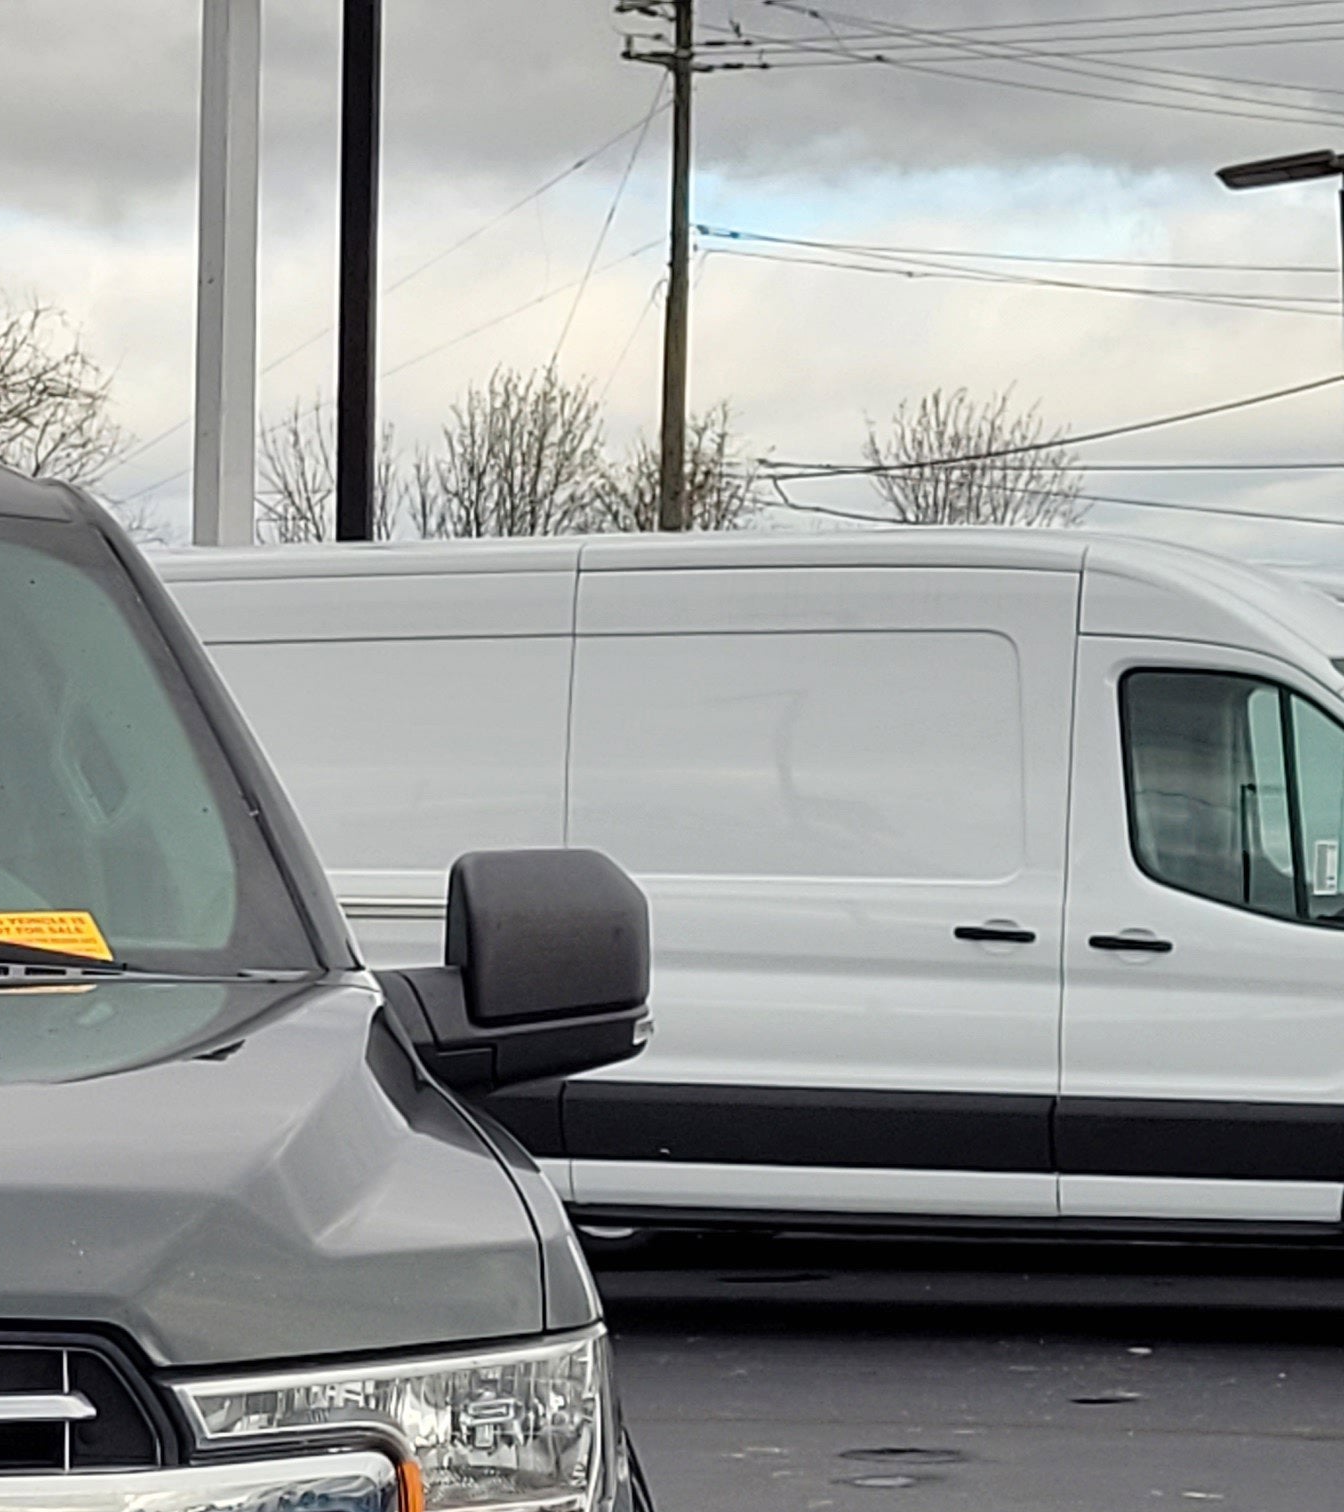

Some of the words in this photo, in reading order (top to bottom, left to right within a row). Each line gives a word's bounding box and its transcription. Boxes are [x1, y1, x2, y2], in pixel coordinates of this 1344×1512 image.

[7, 917, 69, 926] VEHICLE
[71, 917, 86, 926] IS
[16, 926, 47, 935] FOR
[50, 926, 85, 935] SALE
